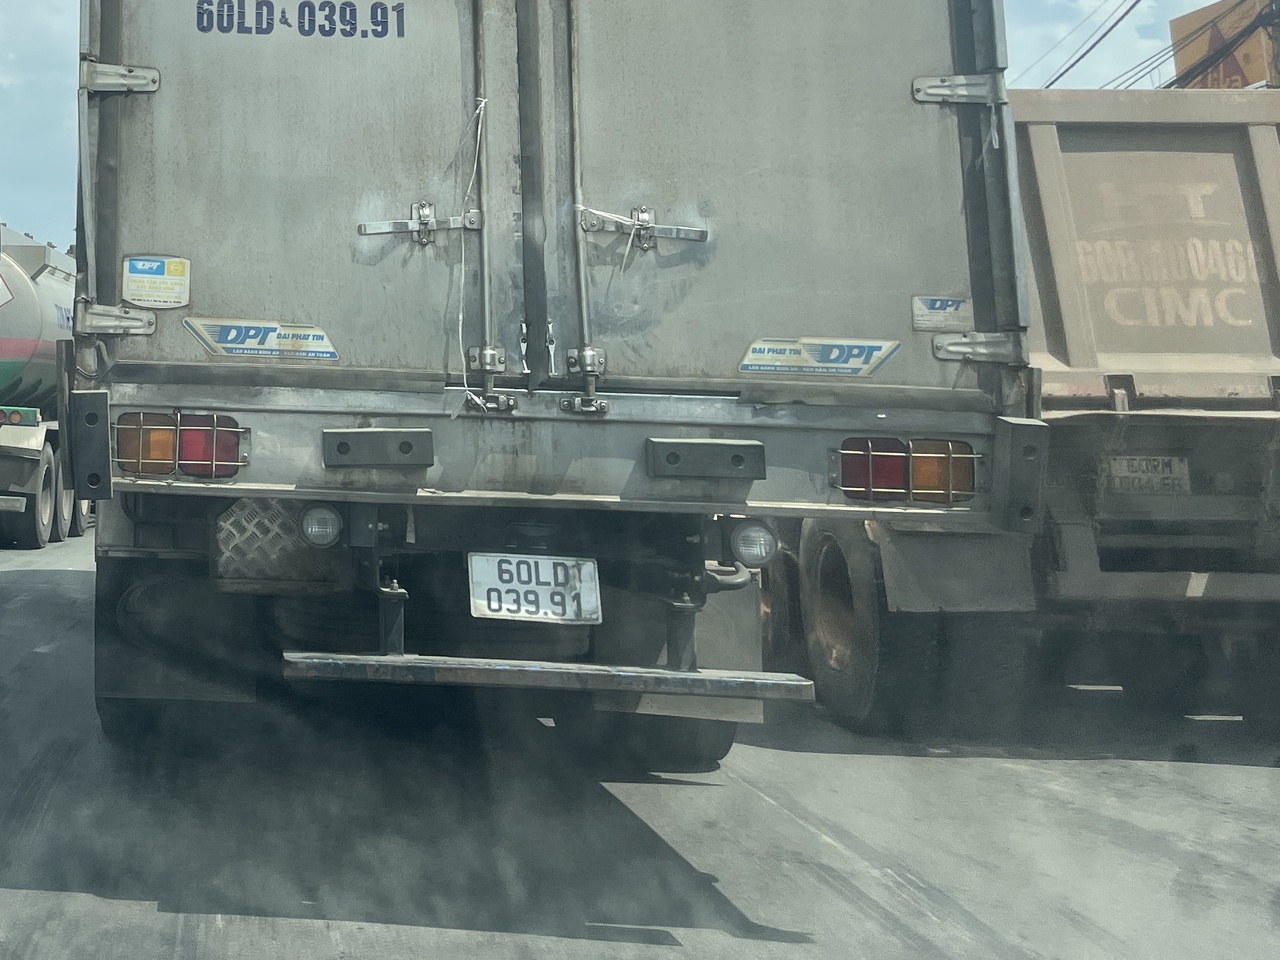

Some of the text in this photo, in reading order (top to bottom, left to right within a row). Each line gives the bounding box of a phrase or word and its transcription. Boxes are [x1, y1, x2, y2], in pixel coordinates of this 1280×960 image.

[297, 0, 405, 38] 039.91
[924, 298, 967, 311] DPT
[1104, 288, 1252, 326] CIMC
[218, 325, 278, 345] DPT
[820, 343, 883, 365] DPT
[497, 558, 570, 588] 60LD
[486, 587, 583, 619] 039.91
